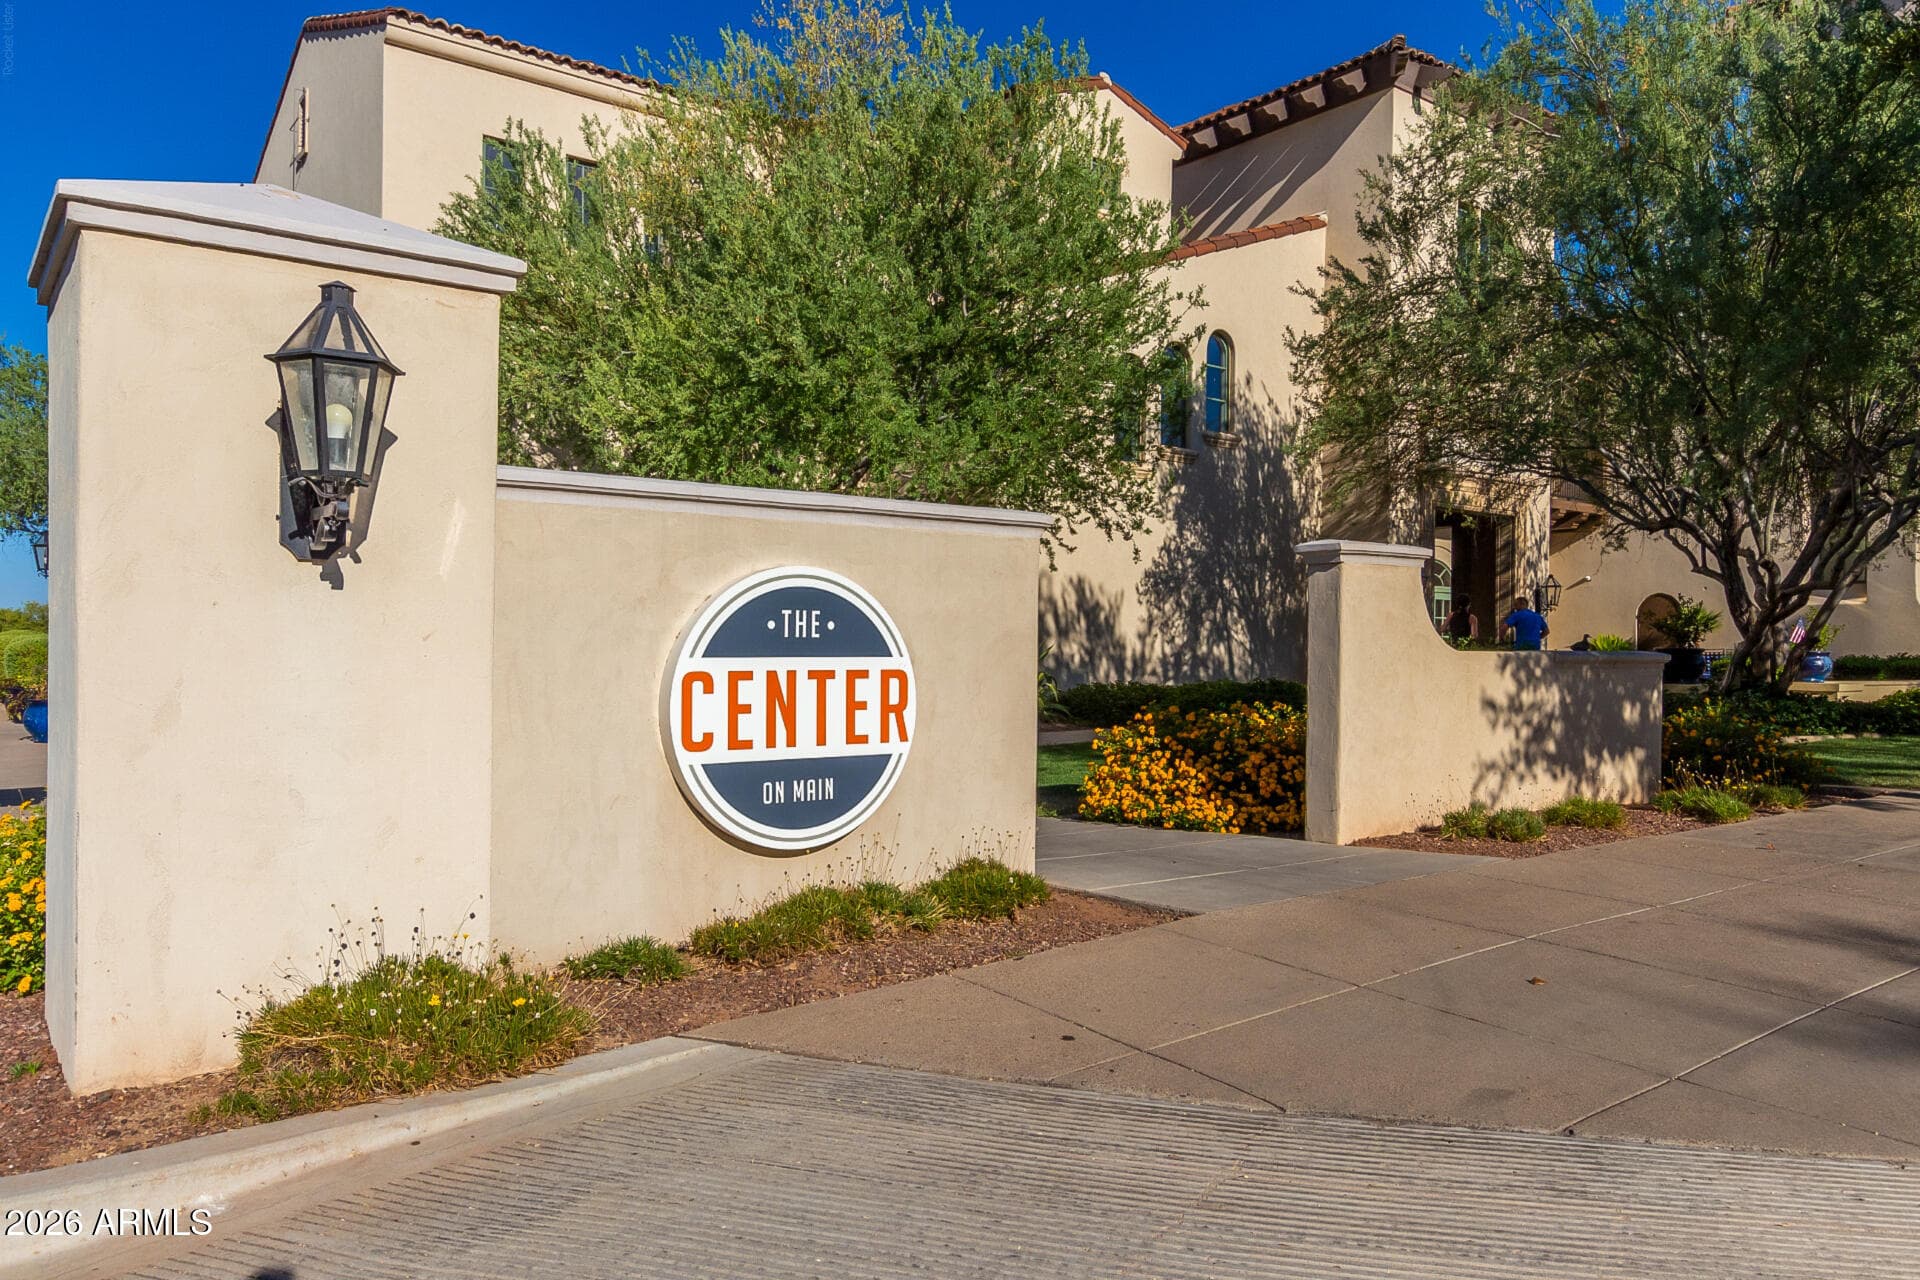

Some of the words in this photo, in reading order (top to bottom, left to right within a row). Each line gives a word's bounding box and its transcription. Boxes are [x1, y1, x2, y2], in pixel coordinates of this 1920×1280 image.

[781, 609, 821, 638] THE
[681, 669, 909, 752] CENTER
[763, 781, 785, 805] ON
[793, 777, 834, 802] MAIN
